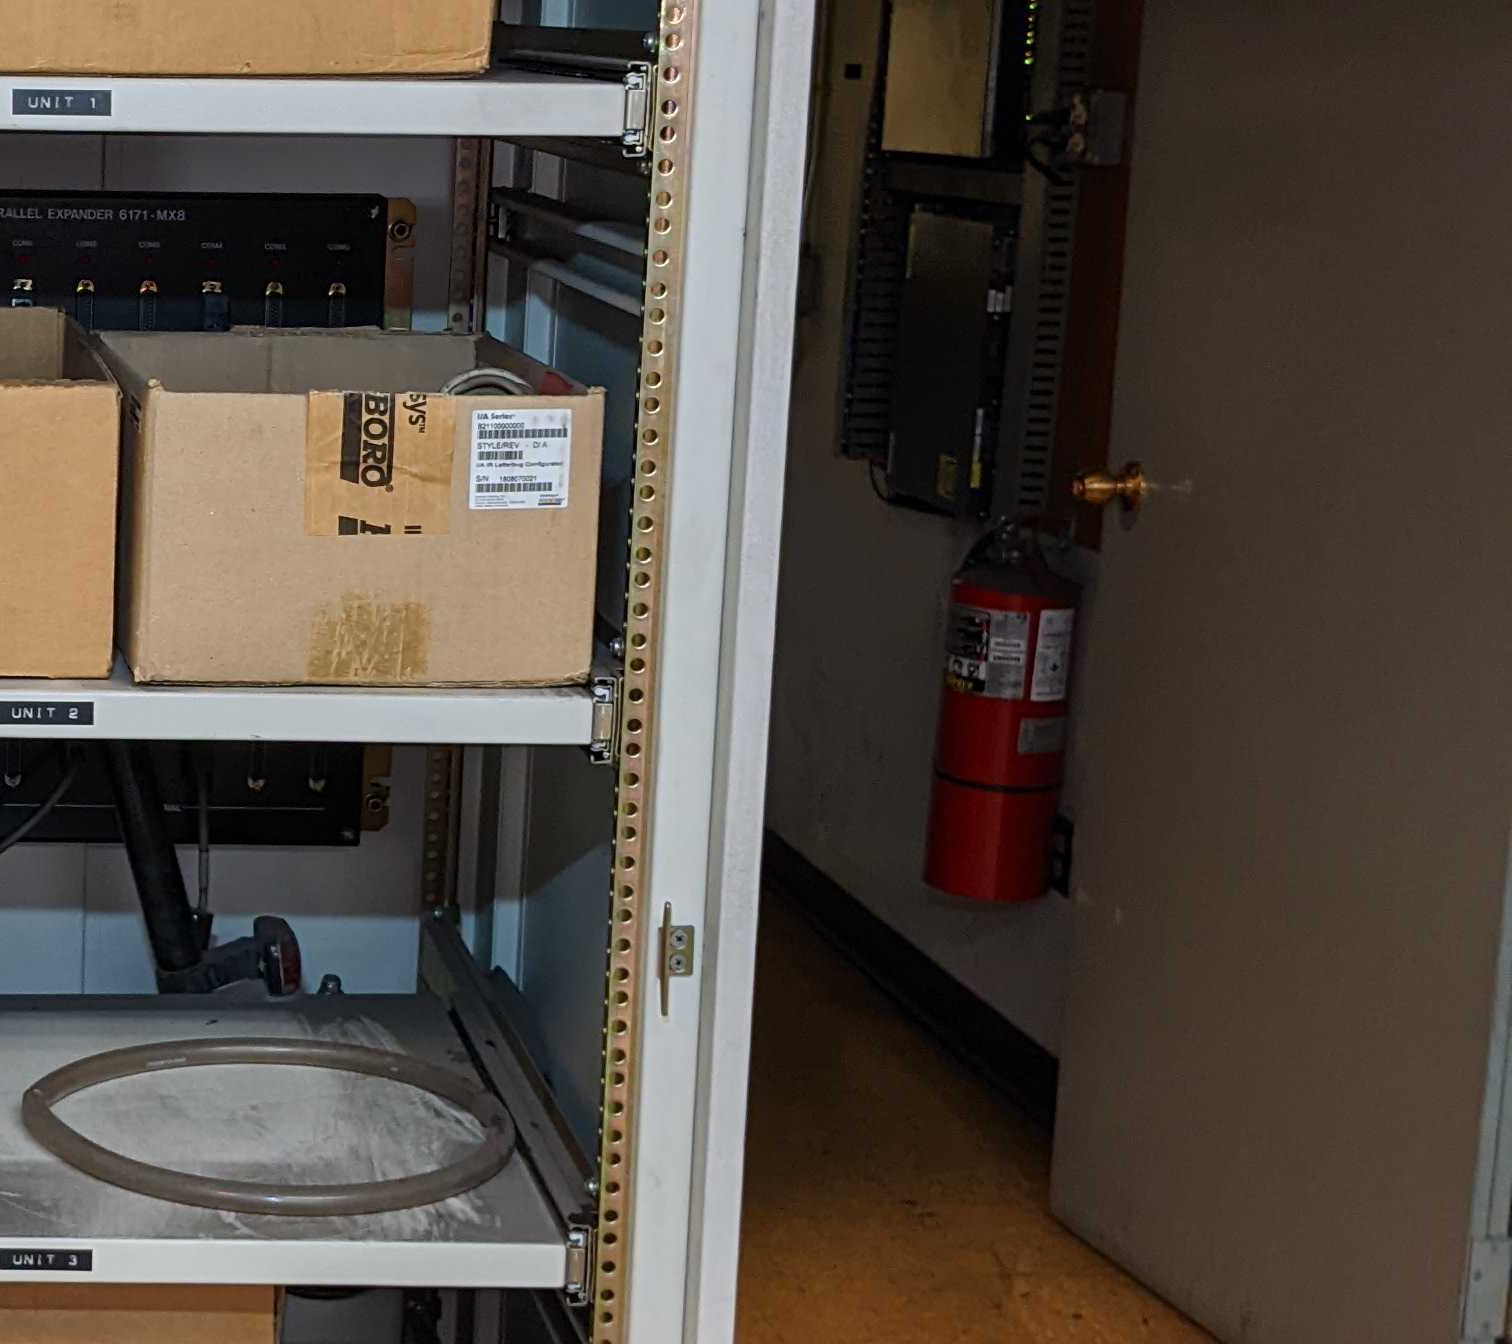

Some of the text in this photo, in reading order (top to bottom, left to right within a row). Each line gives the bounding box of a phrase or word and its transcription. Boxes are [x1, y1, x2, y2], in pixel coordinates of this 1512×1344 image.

[28, 96, 96, 109] UNIT 1
[47, 208, 113, 220] EXPANDER
[119, 209, 186, 222] 6171-MX8
[11, 707, 79, 719] UNIT 2
[12, 1254, 78, 1266] UNIT 3
